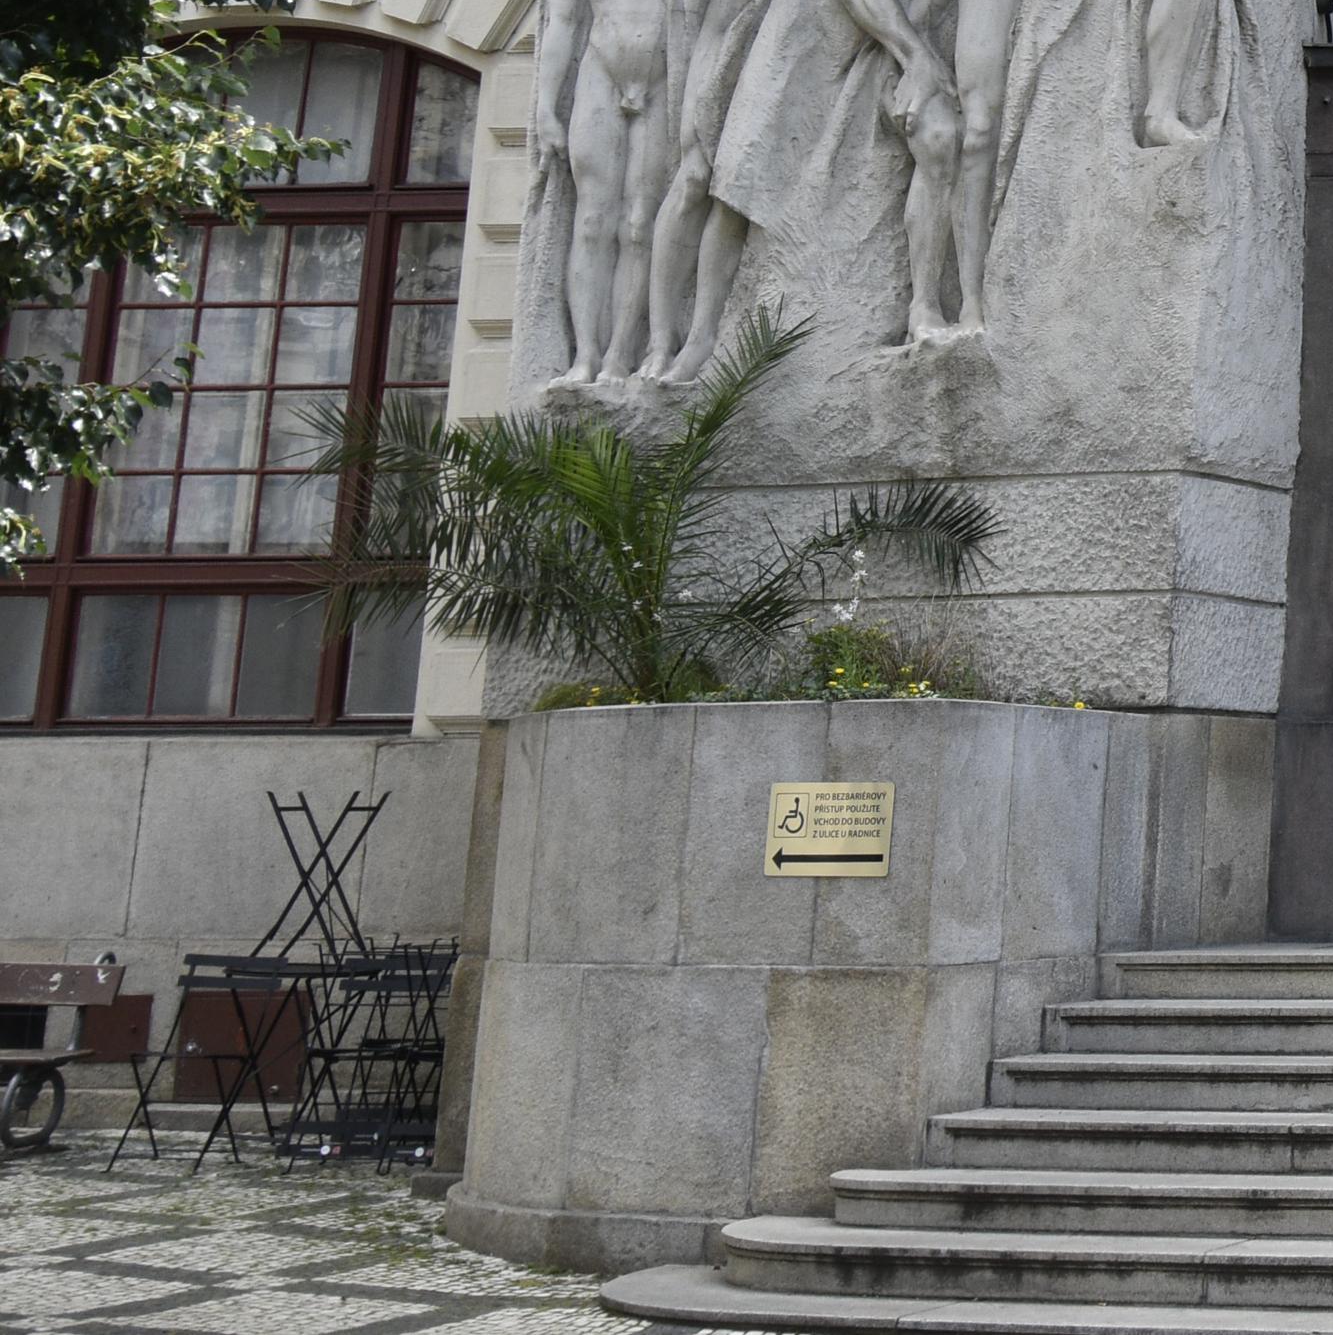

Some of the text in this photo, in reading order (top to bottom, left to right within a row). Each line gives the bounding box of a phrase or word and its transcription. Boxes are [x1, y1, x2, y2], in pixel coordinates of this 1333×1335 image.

[815, 792, 830, 801] PRO
[814, 804, 844, 813] PŘÍSTUP
[813, 817, 886, 826] VCHOD DO BUDOVY
[812, 829, 881, 838] Z ULICE U RADNICE
